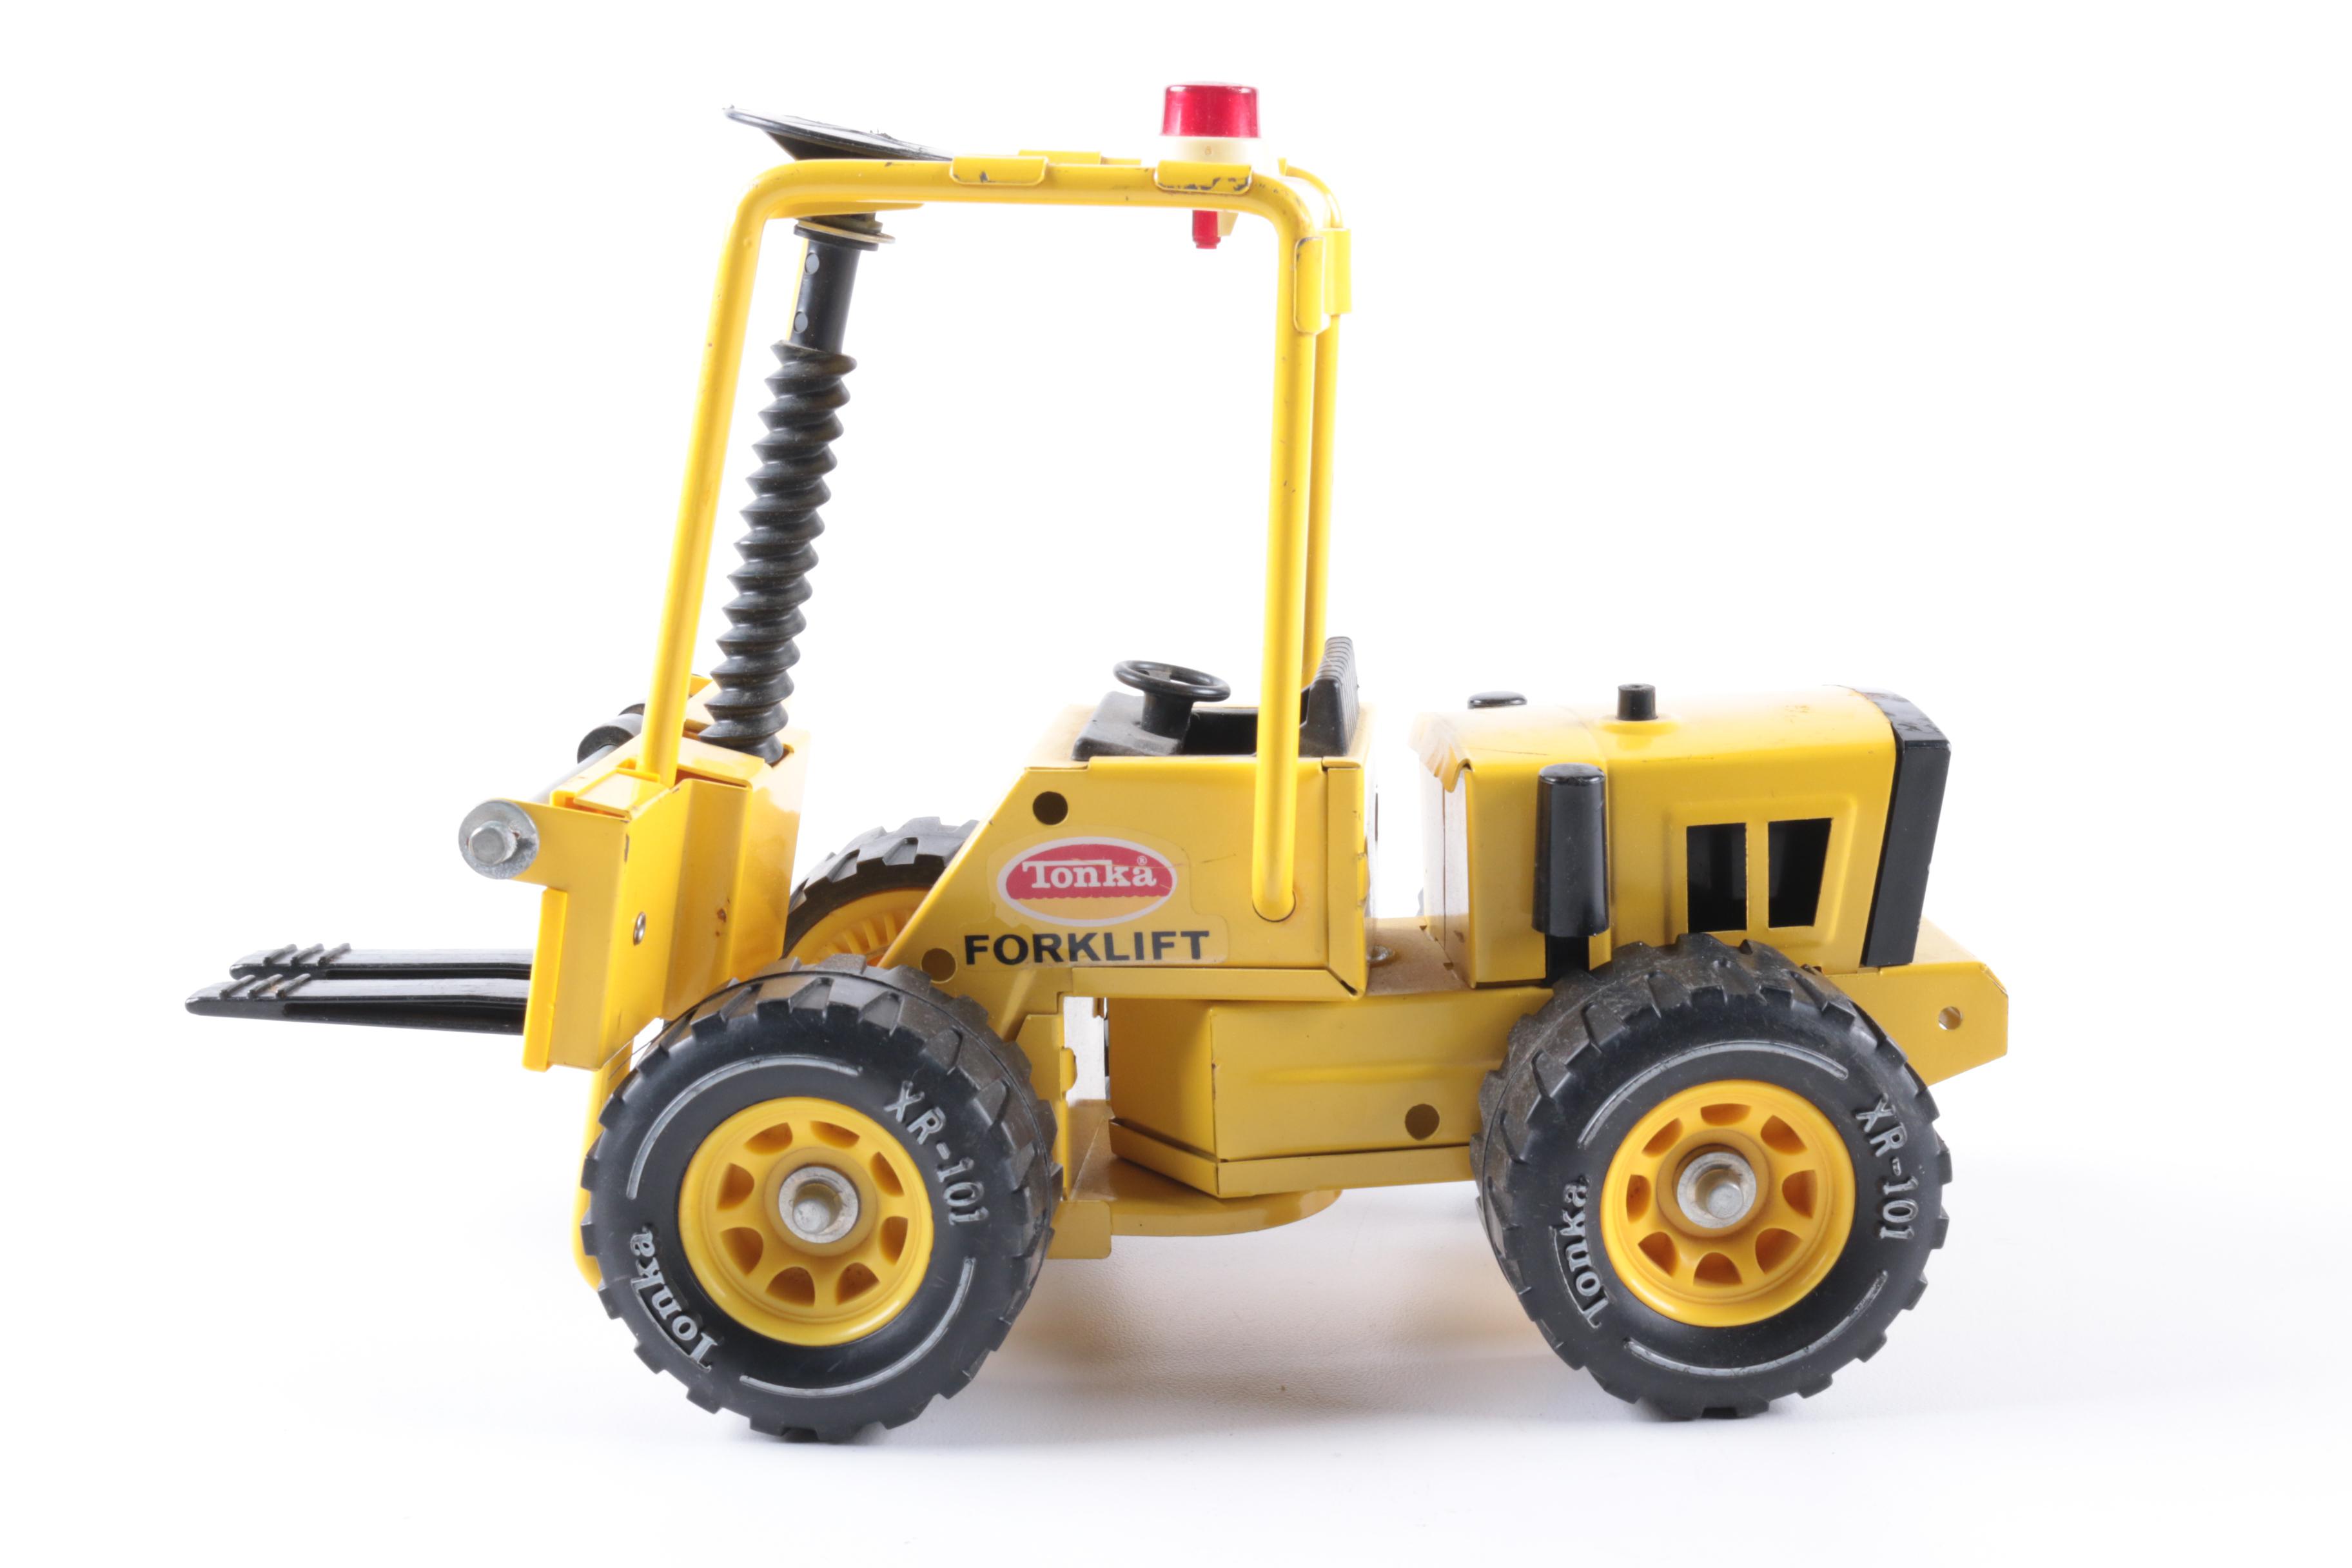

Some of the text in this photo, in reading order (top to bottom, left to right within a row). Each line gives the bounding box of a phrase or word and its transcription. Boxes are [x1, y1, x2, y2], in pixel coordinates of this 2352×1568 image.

[964, 930, 1210, 966] FORKLIFT
[883, 1081, 990, 1225] XR-101
[1855, 1094, 1920, 1240] XR-101
[629, 1230, 720, 1371] Tonka
[1550, 1181, 1609, 1328] Tonka
